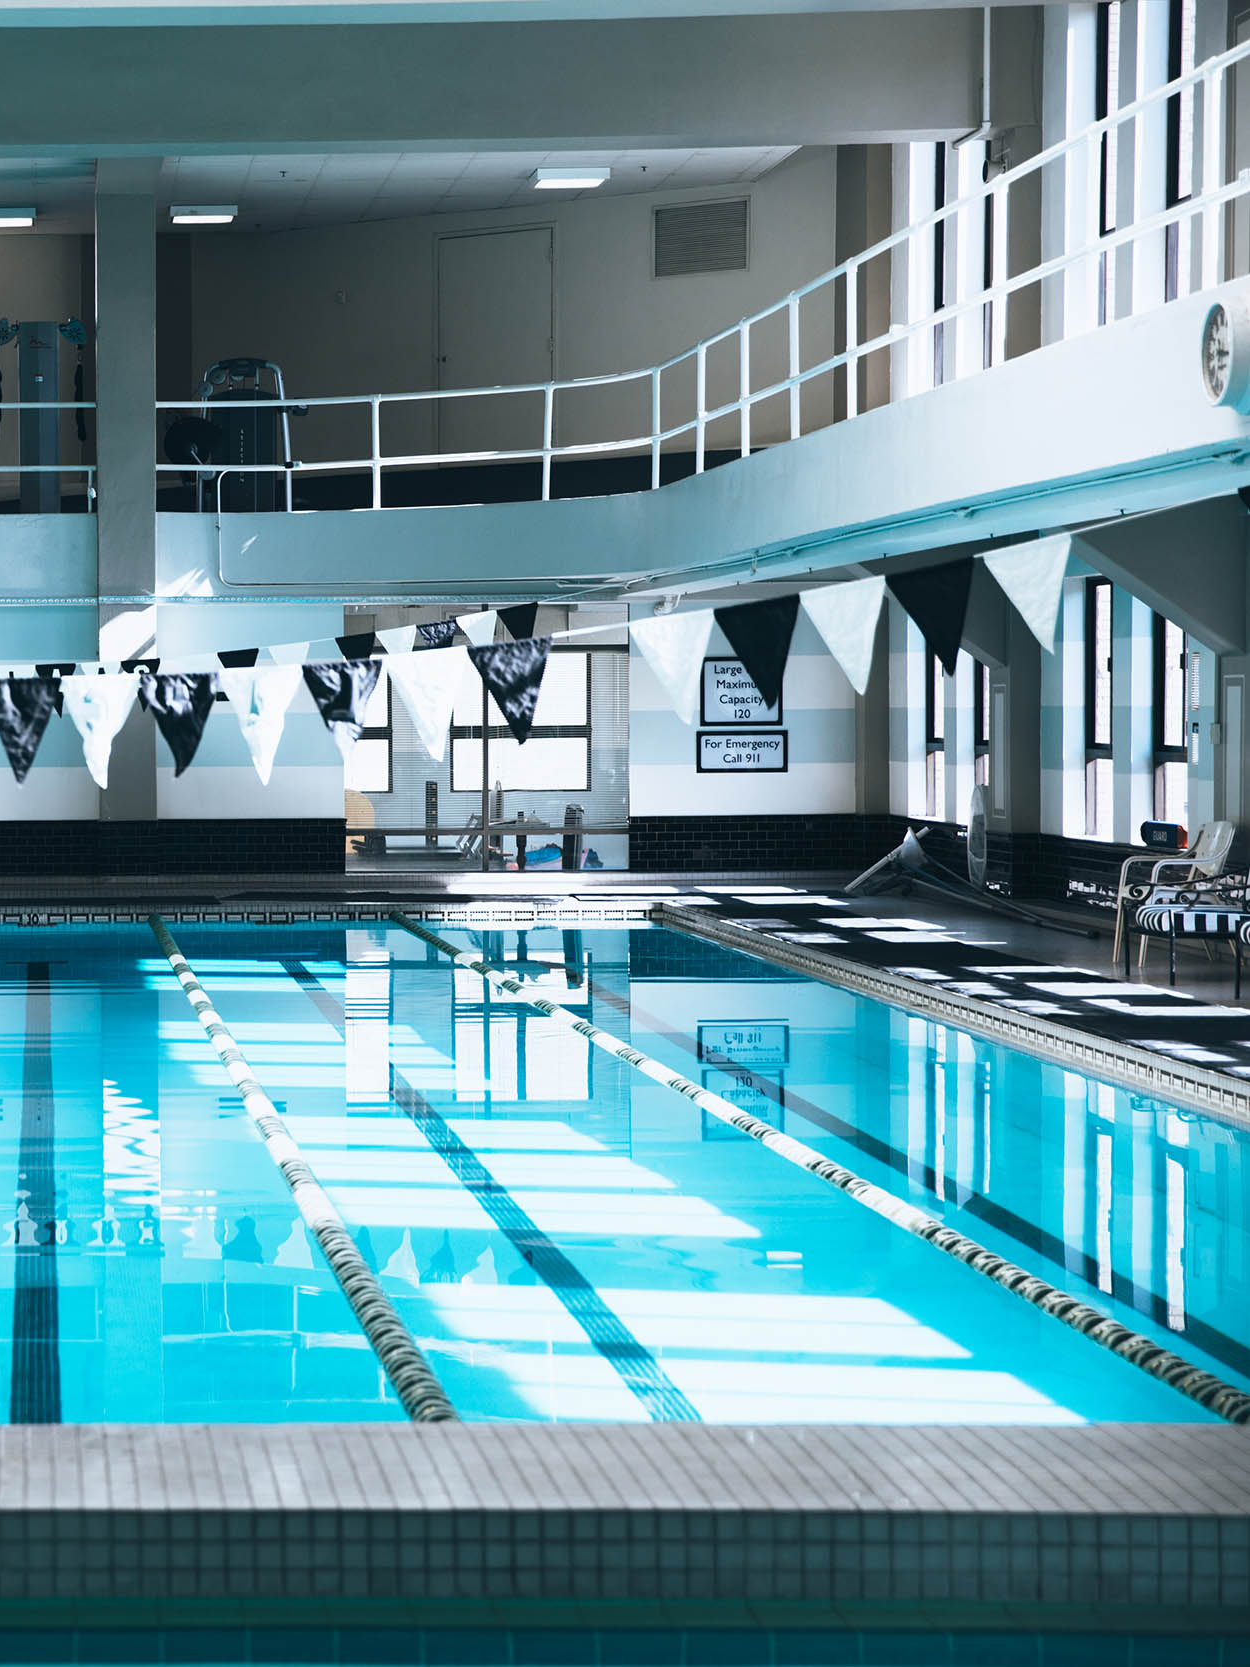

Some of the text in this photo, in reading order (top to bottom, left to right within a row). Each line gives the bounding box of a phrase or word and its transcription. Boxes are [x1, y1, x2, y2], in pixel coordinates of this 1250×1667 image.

[714, 664, 742, 676] Large
[716, 679, 758, 689] Maximu
[719, 694, 764, 706] Capacity
[734, 709, 751, 719] 120
[705, 739, 780, 751] For Emergency
[723, 753, 760, 763] Call 911
